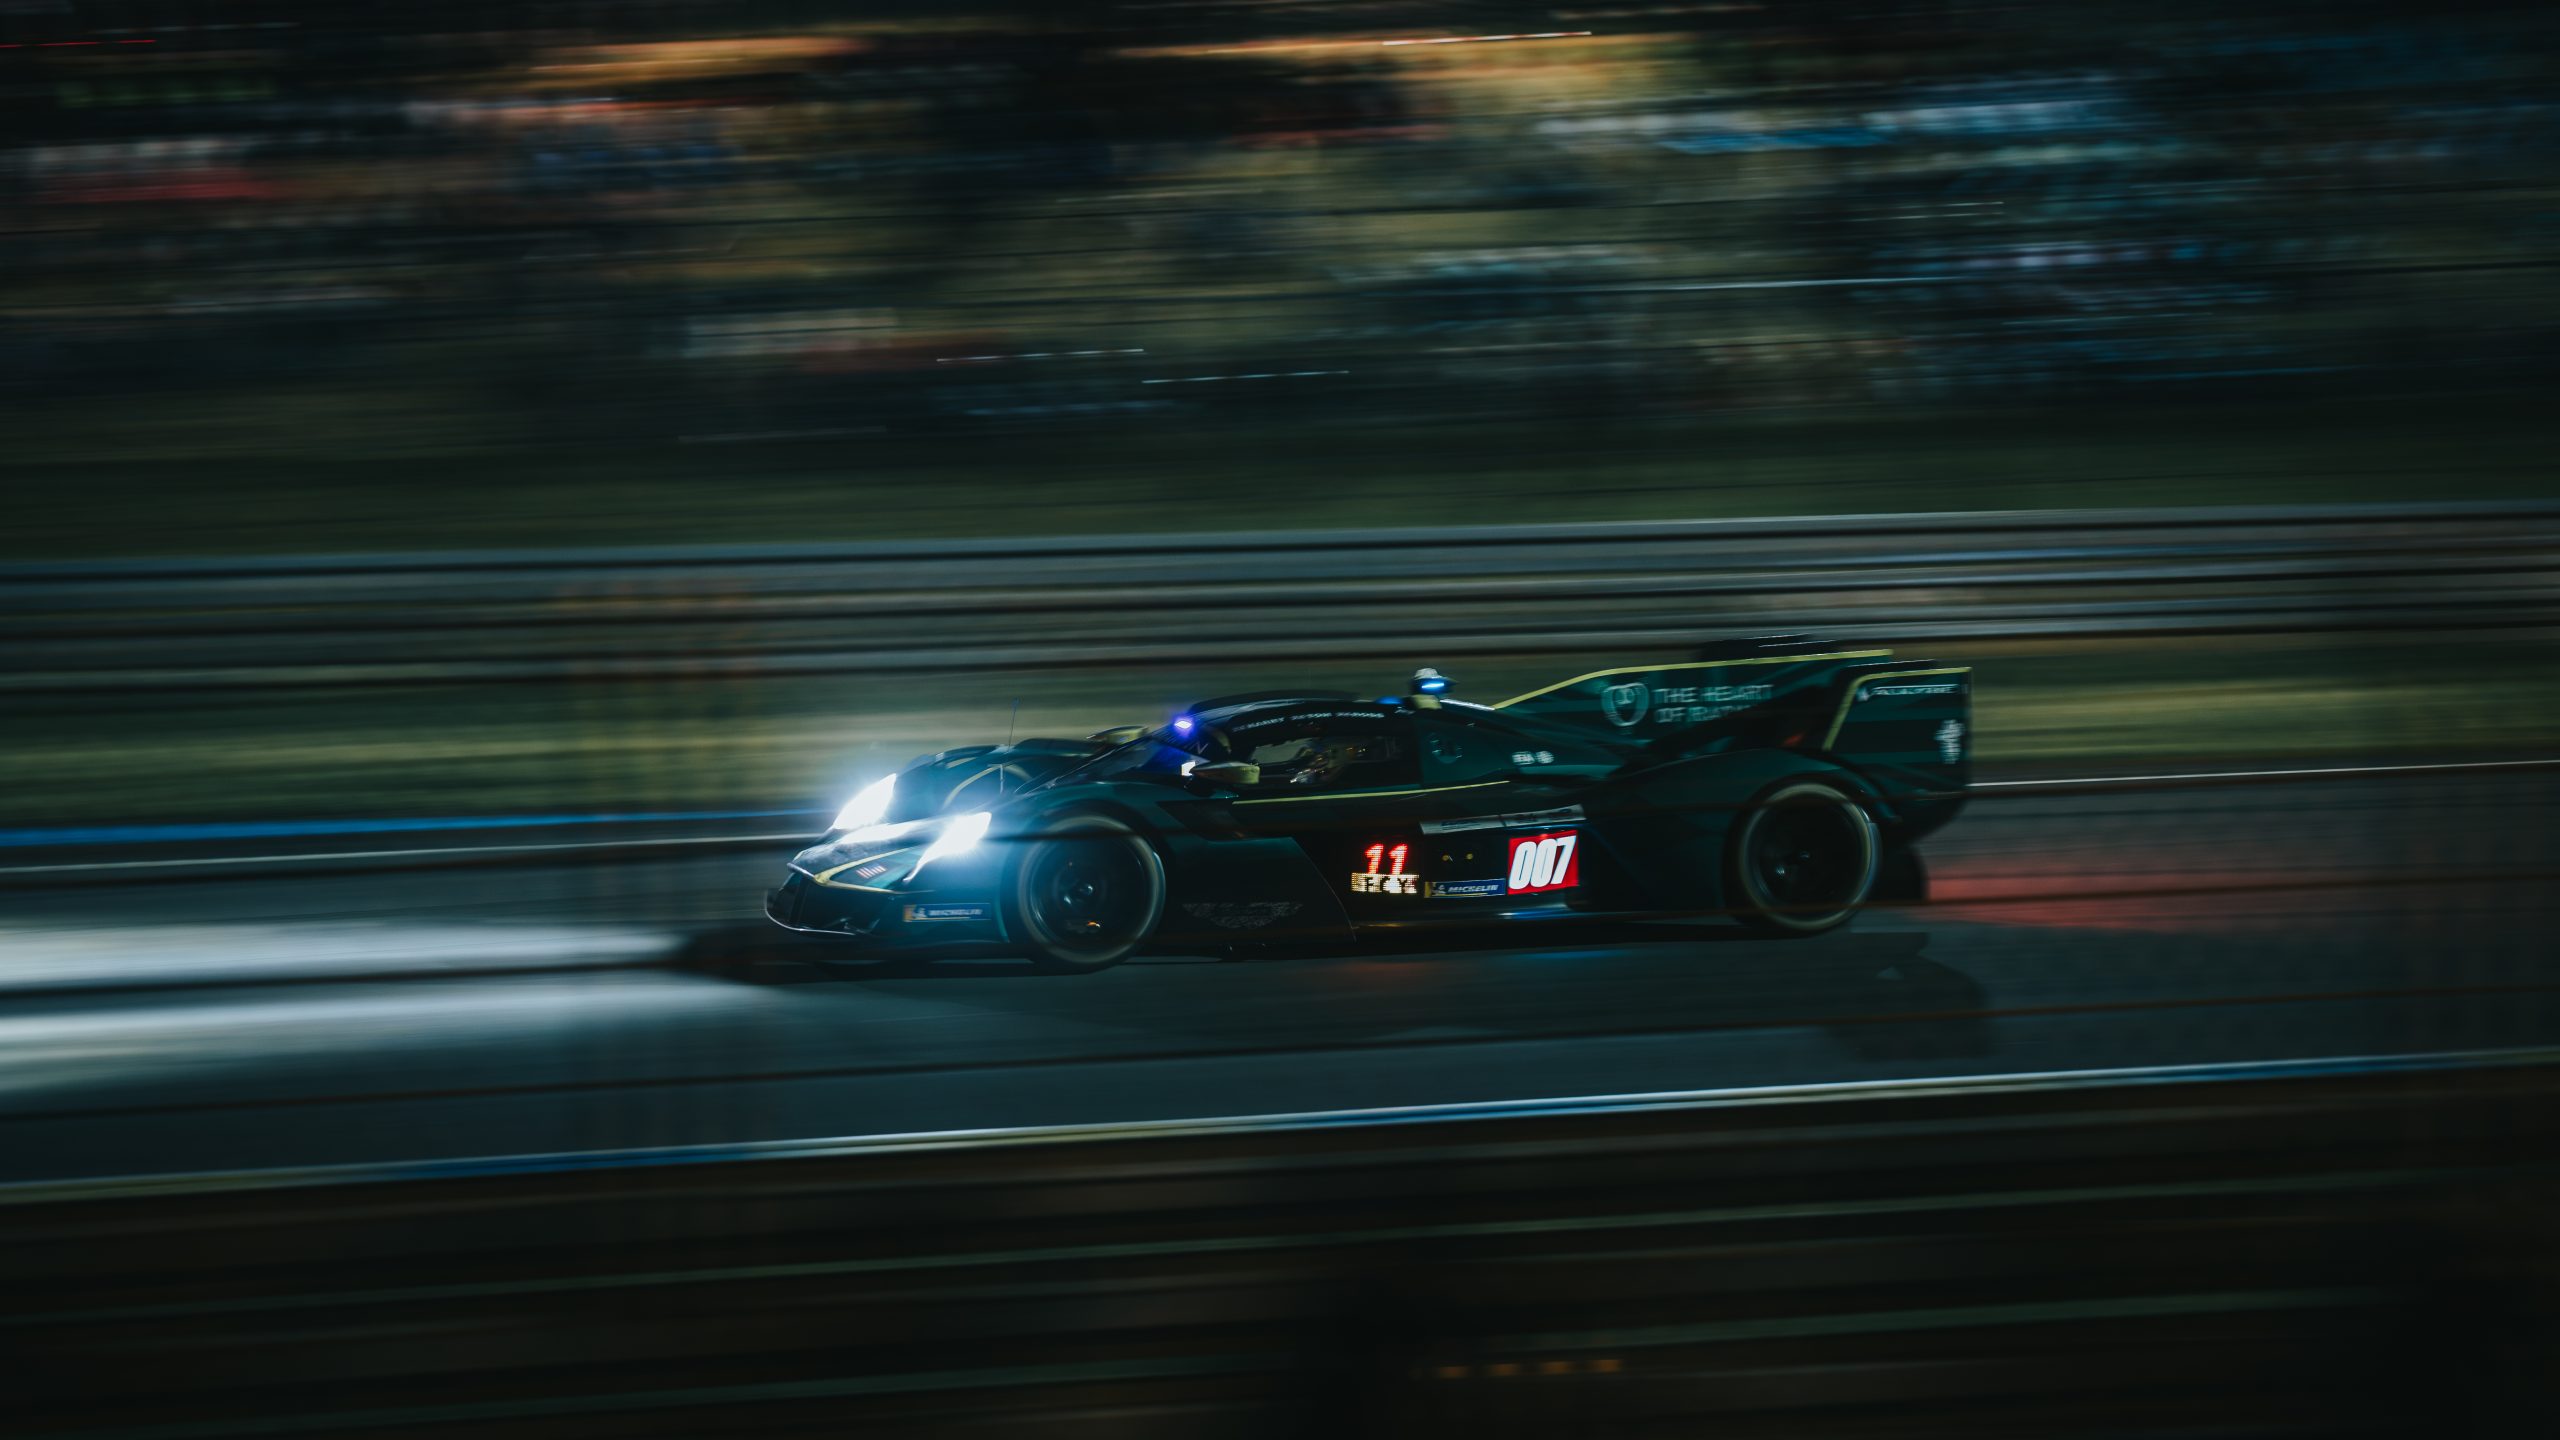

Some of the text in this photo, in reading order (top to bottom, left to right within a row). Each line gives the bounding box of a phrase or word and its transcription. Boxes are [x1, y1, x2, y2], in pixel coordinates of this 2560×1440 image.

[1651, 687, 1699, 704] THE
[1365, 843, 1408, 875] 11
[1509, 834, 1577, 890] 007
[1447, 884, 1499, 894] MICHELIN
